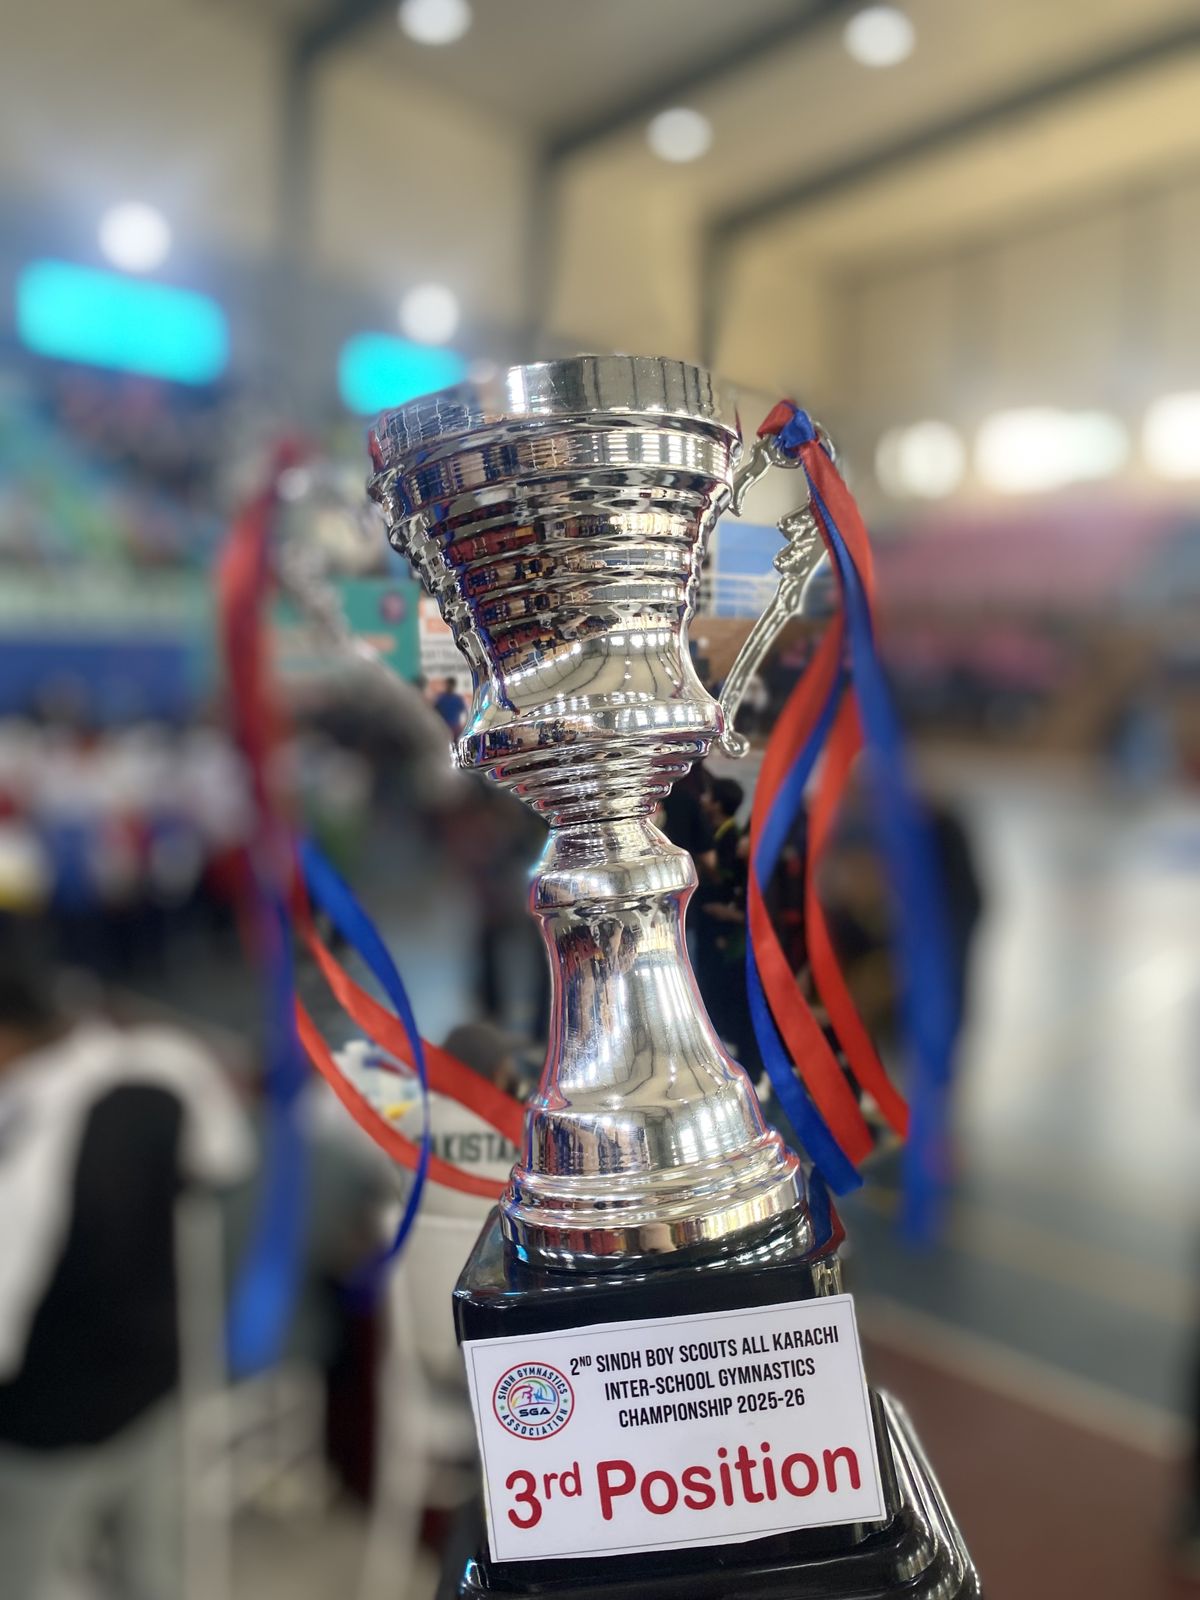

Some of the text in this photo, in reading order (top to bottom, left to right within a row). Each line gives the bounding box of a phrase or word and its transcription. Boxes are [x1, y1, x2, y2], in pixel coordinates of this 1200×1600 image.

[570, 1325, 839, 1376] 2ND SINDH BOY SCOUTS ALL KARACHI
[497, 1367, 568, 1400] SINDH GYMNASTICS
[604, 1357, 816, 1401] INTER-SCHOOL GYMNASTICS
[501, 1408, 568, 1436] ASSOCIATION
[519, 1407, 551, 1417] SGA
[619, 1388, 805, 1428] CHAMPIONSHIP 2025-26
[505, 1441, 861, 1529] 3rd Position
